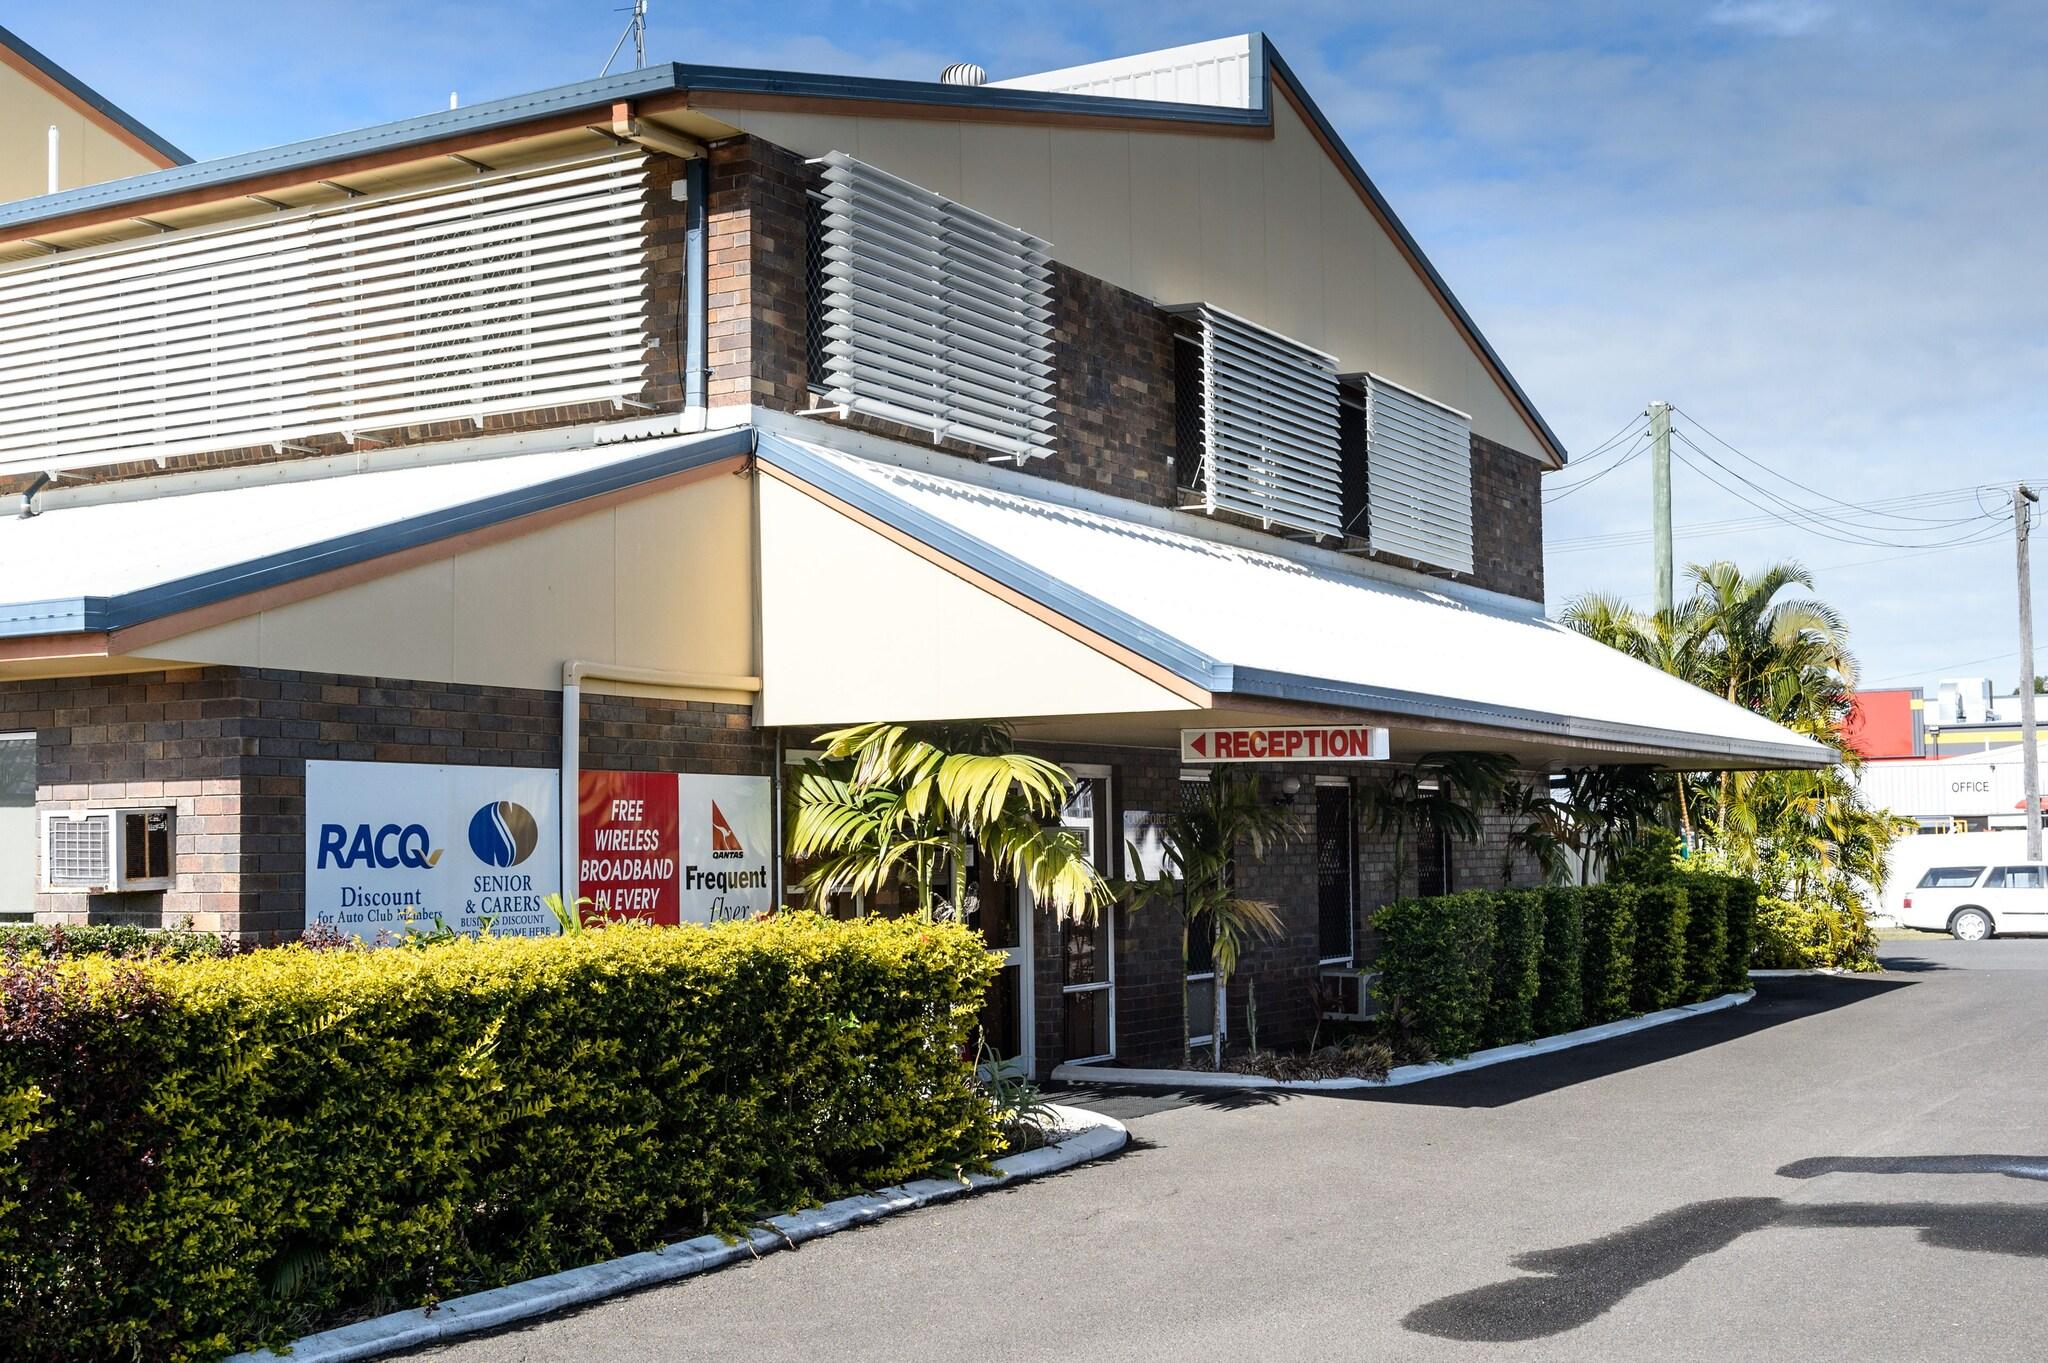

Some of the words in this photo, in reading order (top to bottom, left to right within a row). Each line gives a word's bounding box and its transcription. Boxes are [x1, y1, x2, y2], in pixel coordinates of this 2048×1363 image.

[1214, 729, 1368, 758] RECEPTION
[1951, 781, 1989, 793] OFFICE
[611, 799, 644, 822] FREE
[317, 823, 444, 870] RACQ
[594, 829, 660, 851] WIRELESS
[712, 851, 744, 859] QANTAS
[580, 858, 674, 882] BROADBAND
[686, 865, 767, 894] Frequent
[473, 875, 532, 893] SENIOR
[341, 886, 422, 907] Discount
[465, 899, 476, 914] &
[481, 895, 541, 914] CARERS
[594, 889, 612, 912] IN
[614, 887, 661, 911] EVERY
[318, 910, 334, 924] for
[337, 910, 364, 924] Auto
[367, 908, 393, 922] Club
[502, 914, 545, 925] DISCOUNT
[529, 926, 550, 937] HERE
